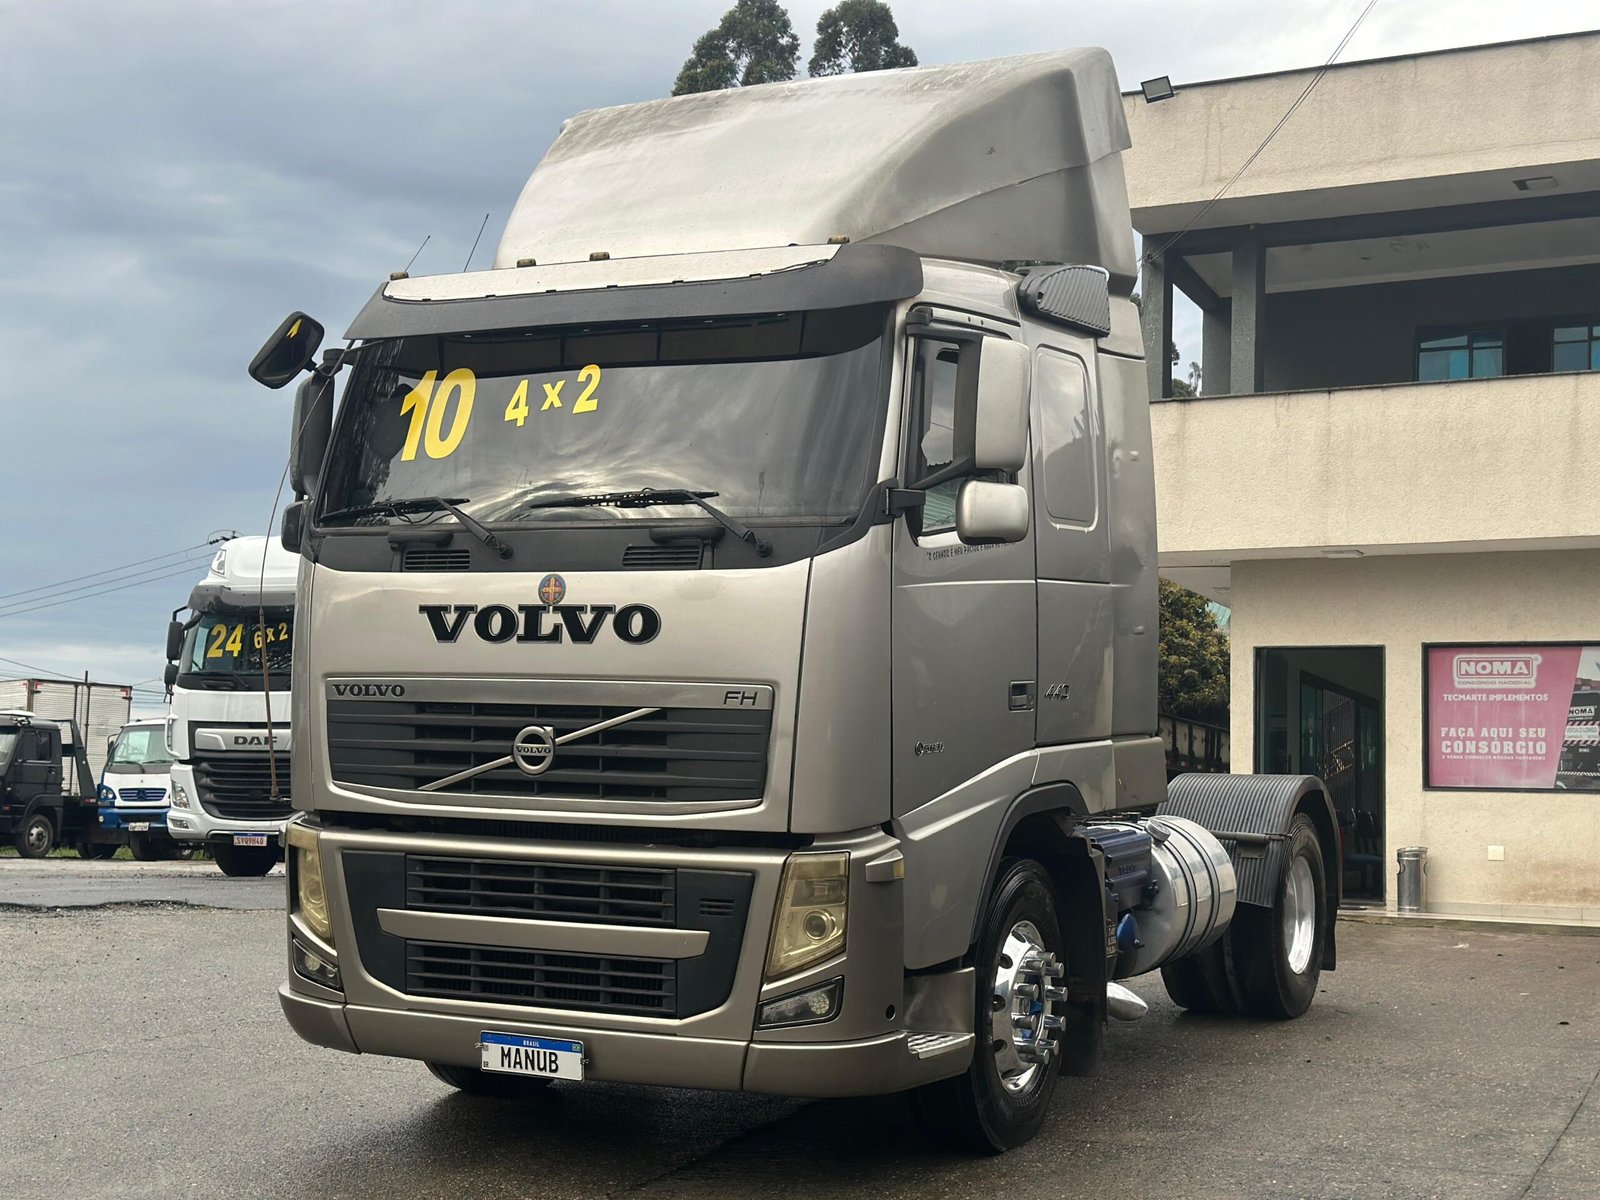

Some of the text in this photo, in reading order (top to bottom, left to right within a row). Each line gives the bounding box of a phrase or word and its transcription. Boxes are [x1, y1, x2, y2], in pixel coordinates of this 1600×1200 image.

[504, 379, 529, 427] 4
[572, 364, 601, 415] 2
[400, 367, 476, 462] 10
[419, 603, 662, 645] VOLVO
[206, 623, 244, 658] 24
[278, 622, 288, 641] 2
[1460, 661, 1529, 675] NOMA
[332, 683, 405, 698] VOLVO
[723, 690, 758, 706] FH
[1443, 693, 1548, 701] TECMARTE IMPLEMENTOS
[233, 736, 278, 746] DAF
[1441, 727, 1546, 740] FAÇA AQUI SEU
[516, 746, 551, 754] VOLVO
[523, 1040, 540, 1048] BRASIL
[501, 1046, 559, 1073] MANUB
